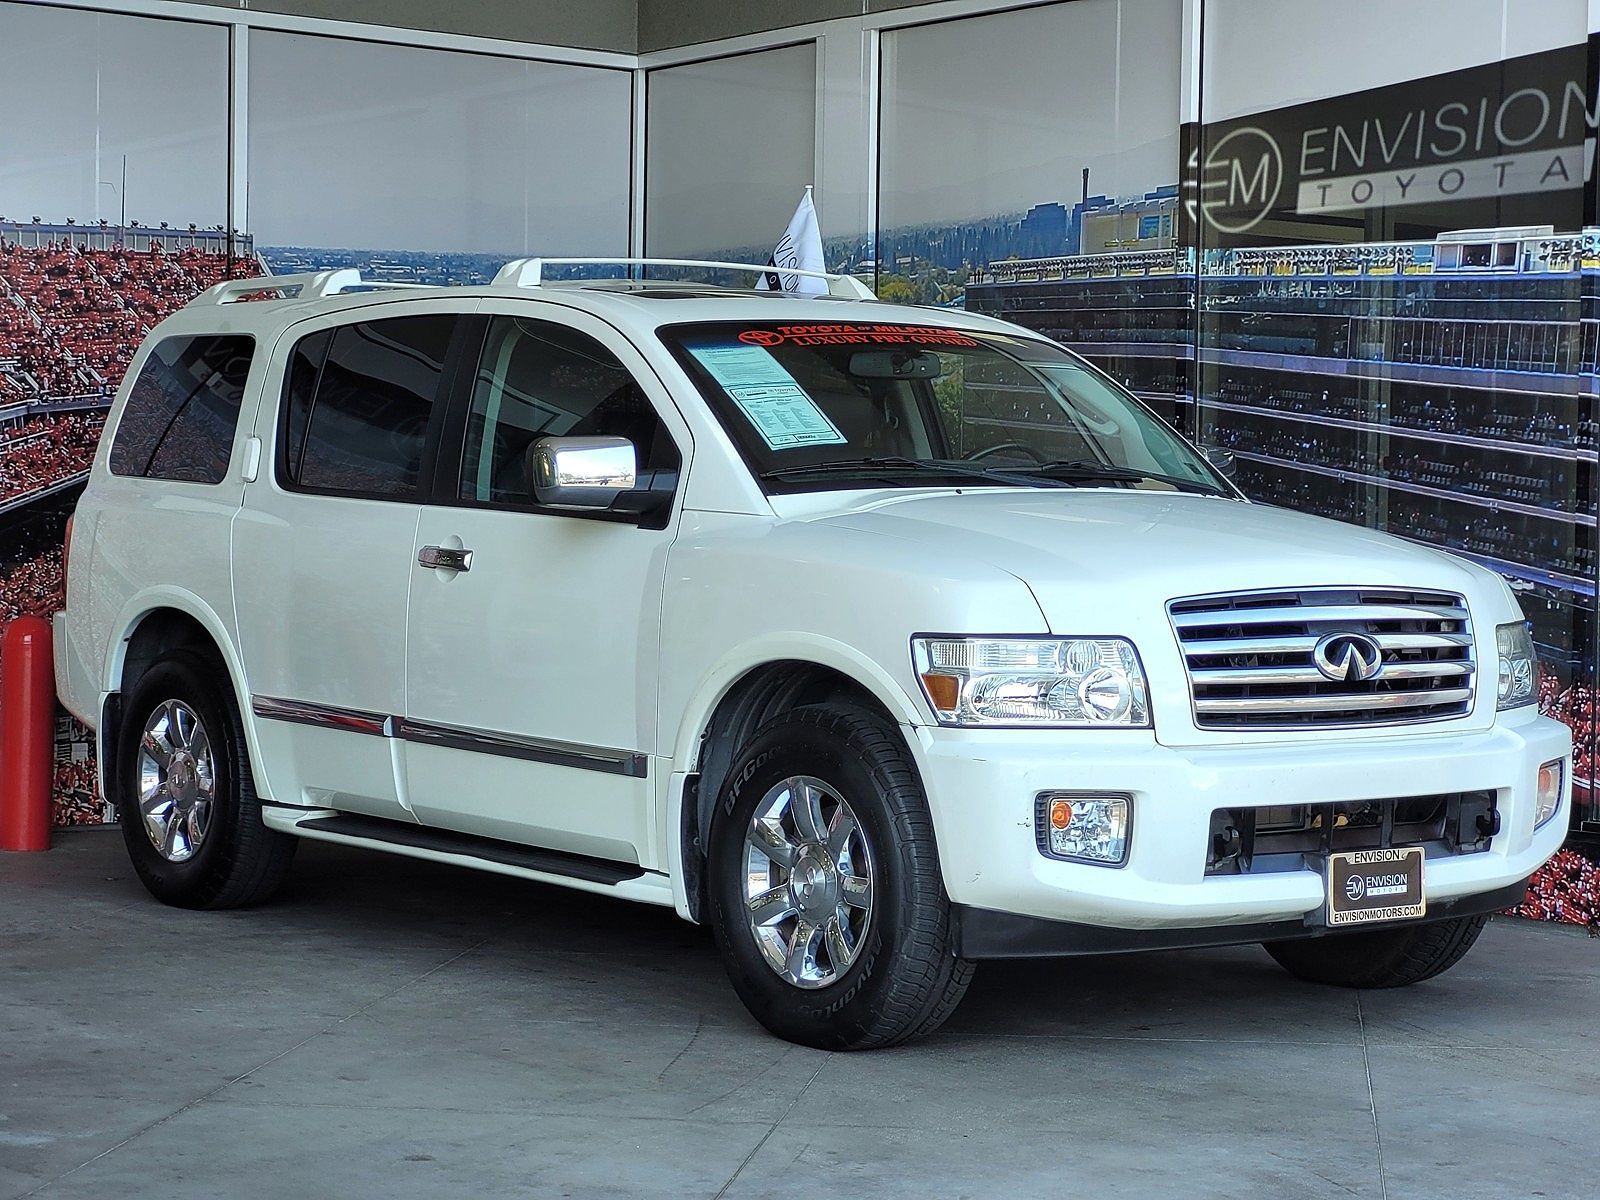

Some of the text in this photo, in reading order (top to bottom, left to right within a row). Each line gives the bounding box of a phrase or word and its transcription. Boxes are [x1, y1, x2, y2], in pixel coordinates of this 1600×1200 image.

[1301, 81, 1600, 176] ENVISION
[1317, 155, 1569, 207] TOYOTA
[777, 325, 858, 334] TOYOTA
[872, 325, 960, 336] MILPITAS
[792, 335, 977, 346] LUXURY PRE OWNED
[1354, 849, 1400, 863] ENVISION
[1366, 873, 1408, 887] ENVISION
[1334, 906, 1422, 923] ENVISIONMOTORS.COM
